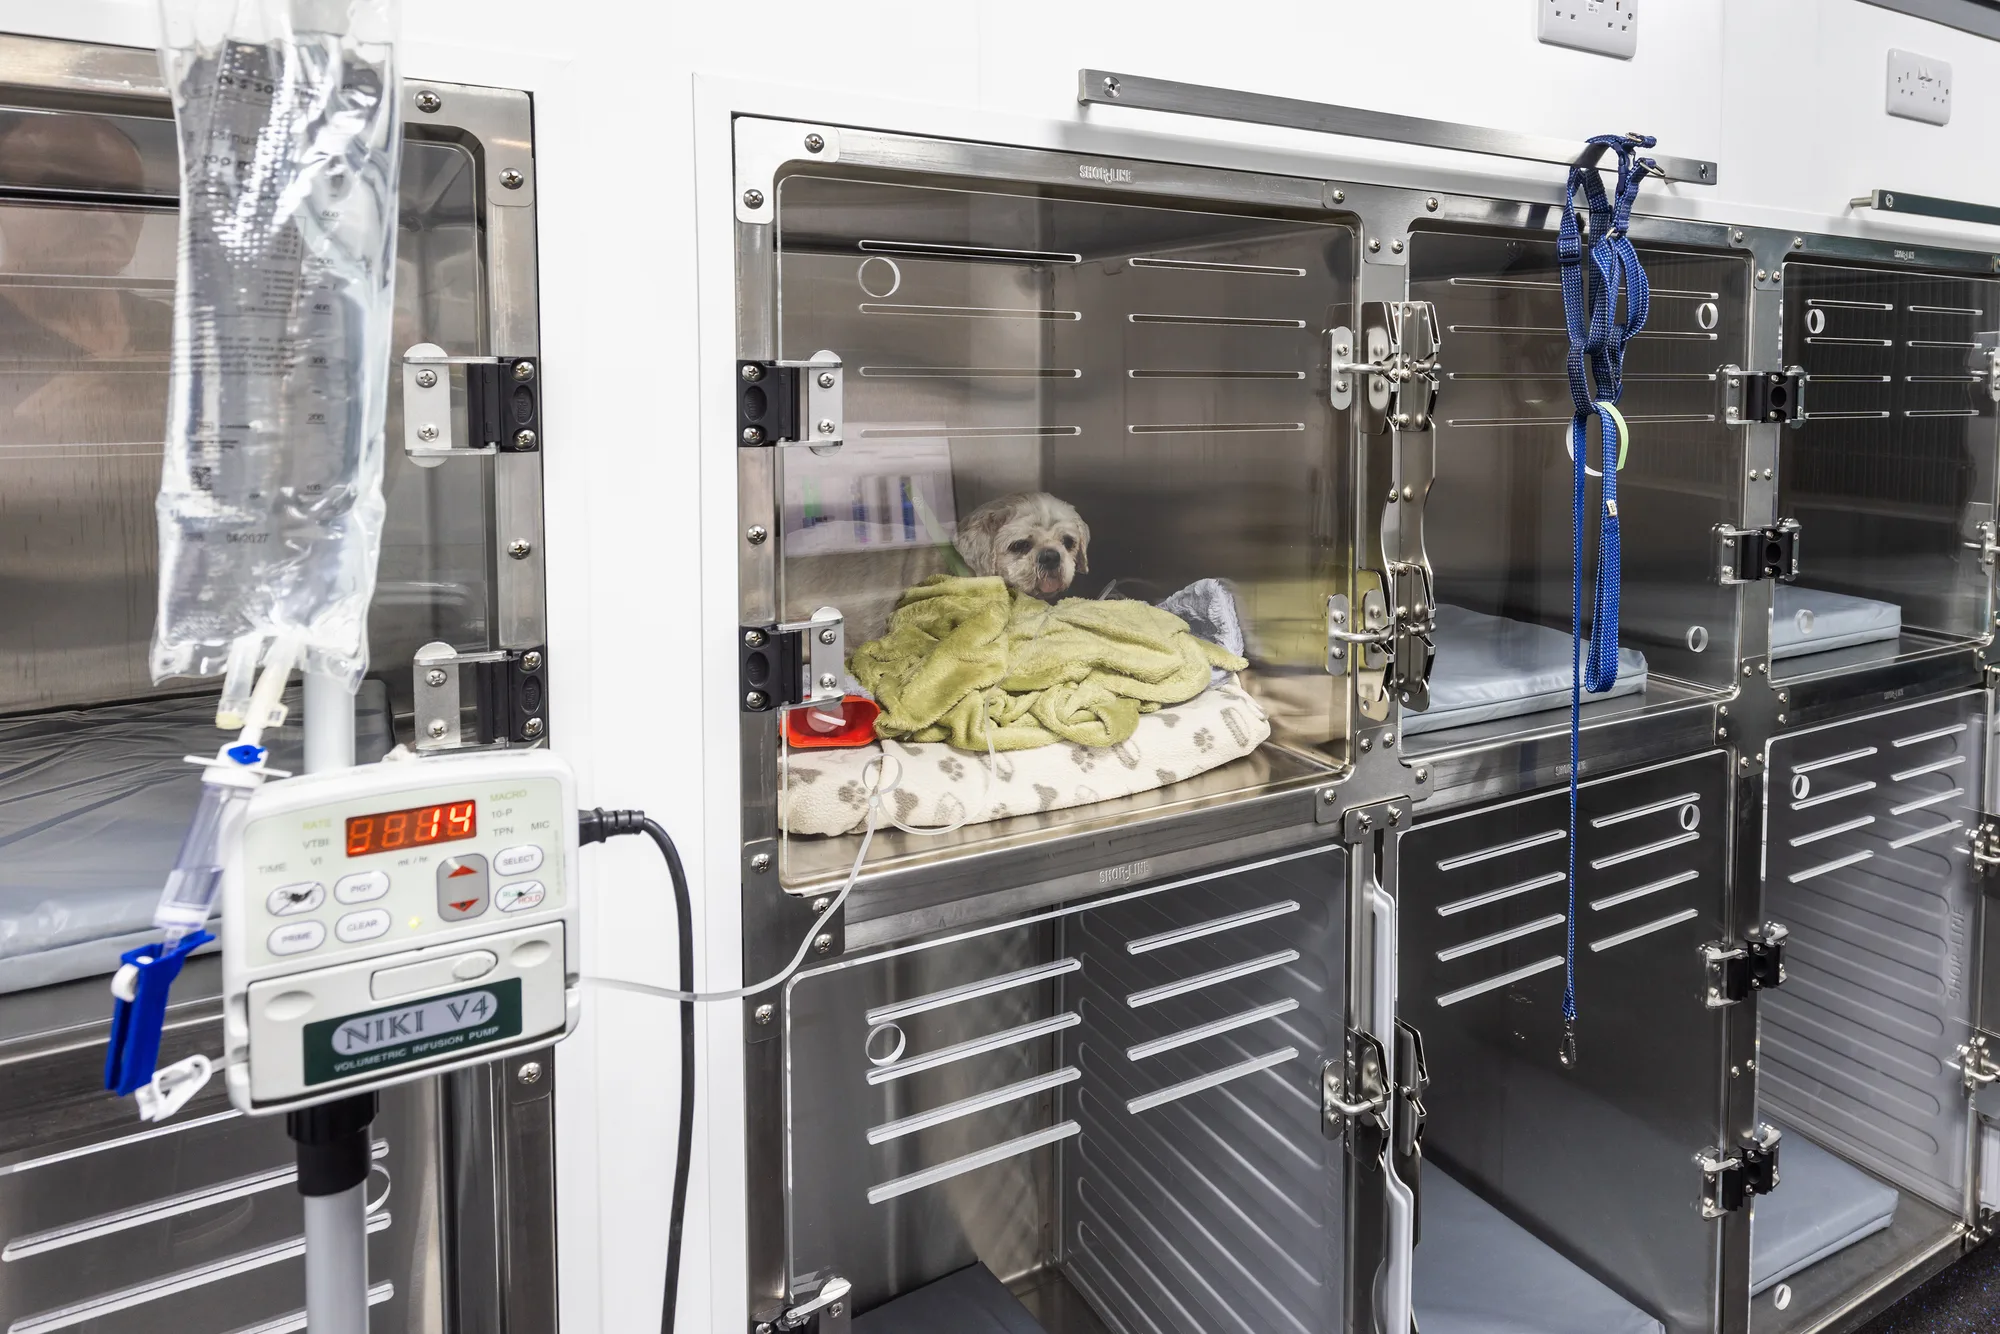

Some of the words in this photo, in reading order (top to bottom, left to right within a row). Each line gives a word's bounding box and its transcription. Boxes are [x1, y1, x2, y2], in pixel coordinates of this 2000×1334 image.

[490, 789, 527, 802] MACRO
[491, 808, 513, 819] 10-P
[302, 818, 332, 831] RATE
[531, 820, 550, 831] MIC
[493, 826, 514, 837] TPN
[503, 854, 535, 866] SELECT
[258, 862, 287, 874] TIME
[346, 919, 378, 932] CLEAR
[281, 931, 312, 943] PRIME
[342, 1010, 424, 1050] NIKI
[447, 995, 490, 1023] V4
[334, 1048, 408, 1073] VOLUMETRIC
[412, 1034, 464, 1054] INFUSION
[468, 1026, 499, 1041] PUMP
